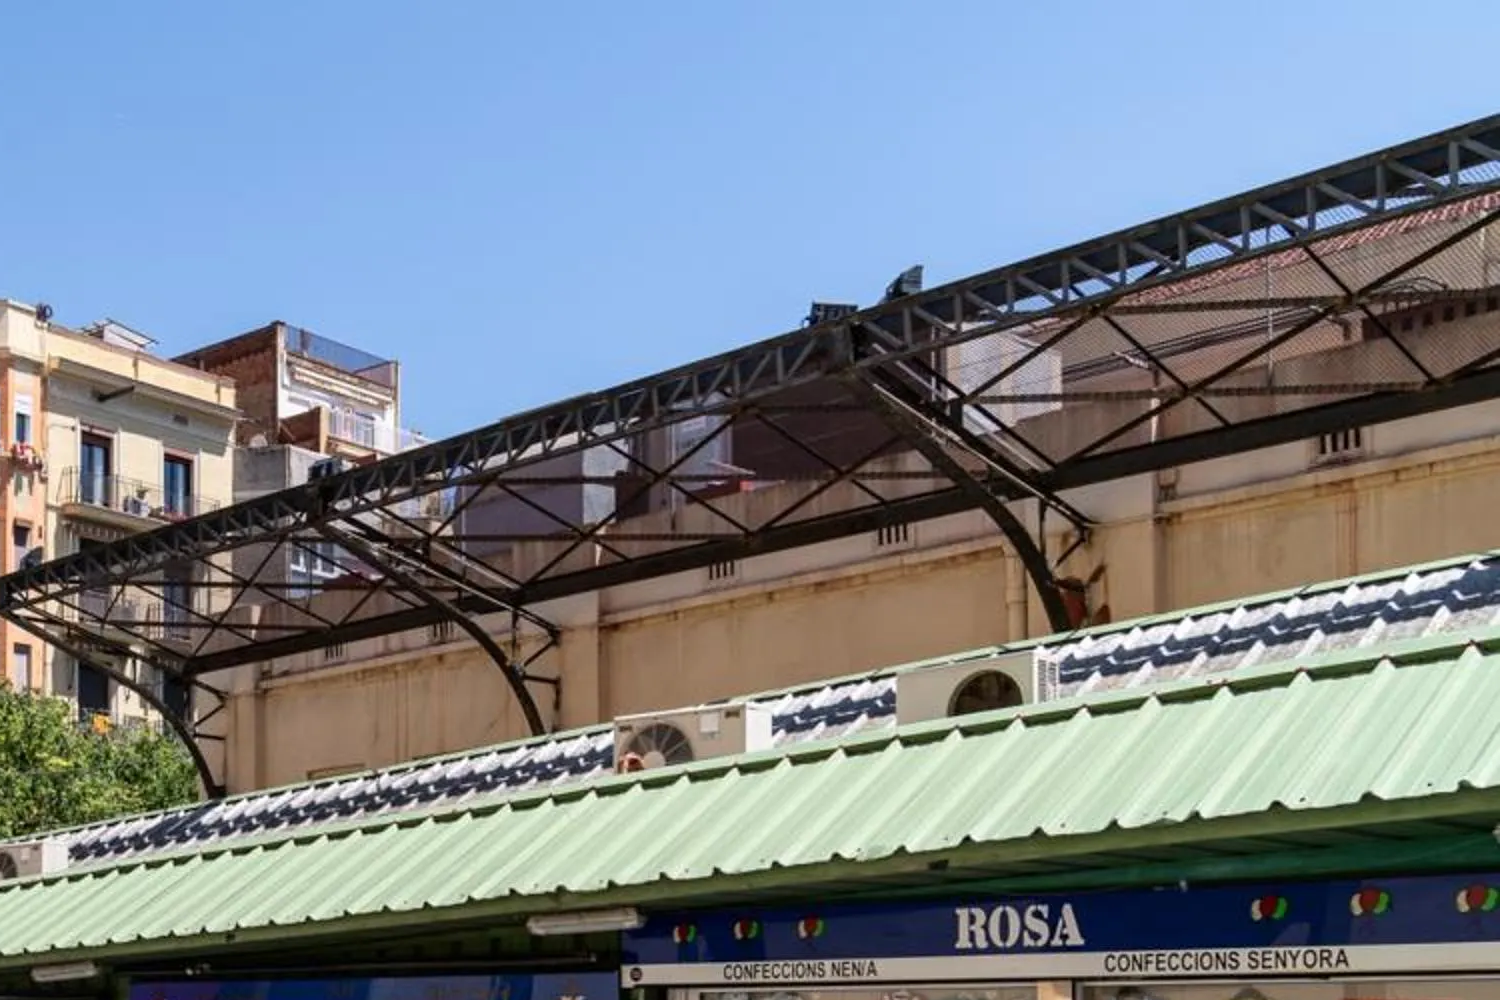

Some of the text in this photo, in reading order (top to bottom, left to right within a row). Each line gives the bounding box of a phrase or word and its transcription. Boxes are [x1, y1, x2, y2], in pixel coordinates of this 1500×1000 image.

[954, 902, 1086, 949] ROSA
[723, 960, 878, 980] CONFECCIONS NEN/A
[1104, 948, 1350, 972] CONFECCIONS SENYORA
